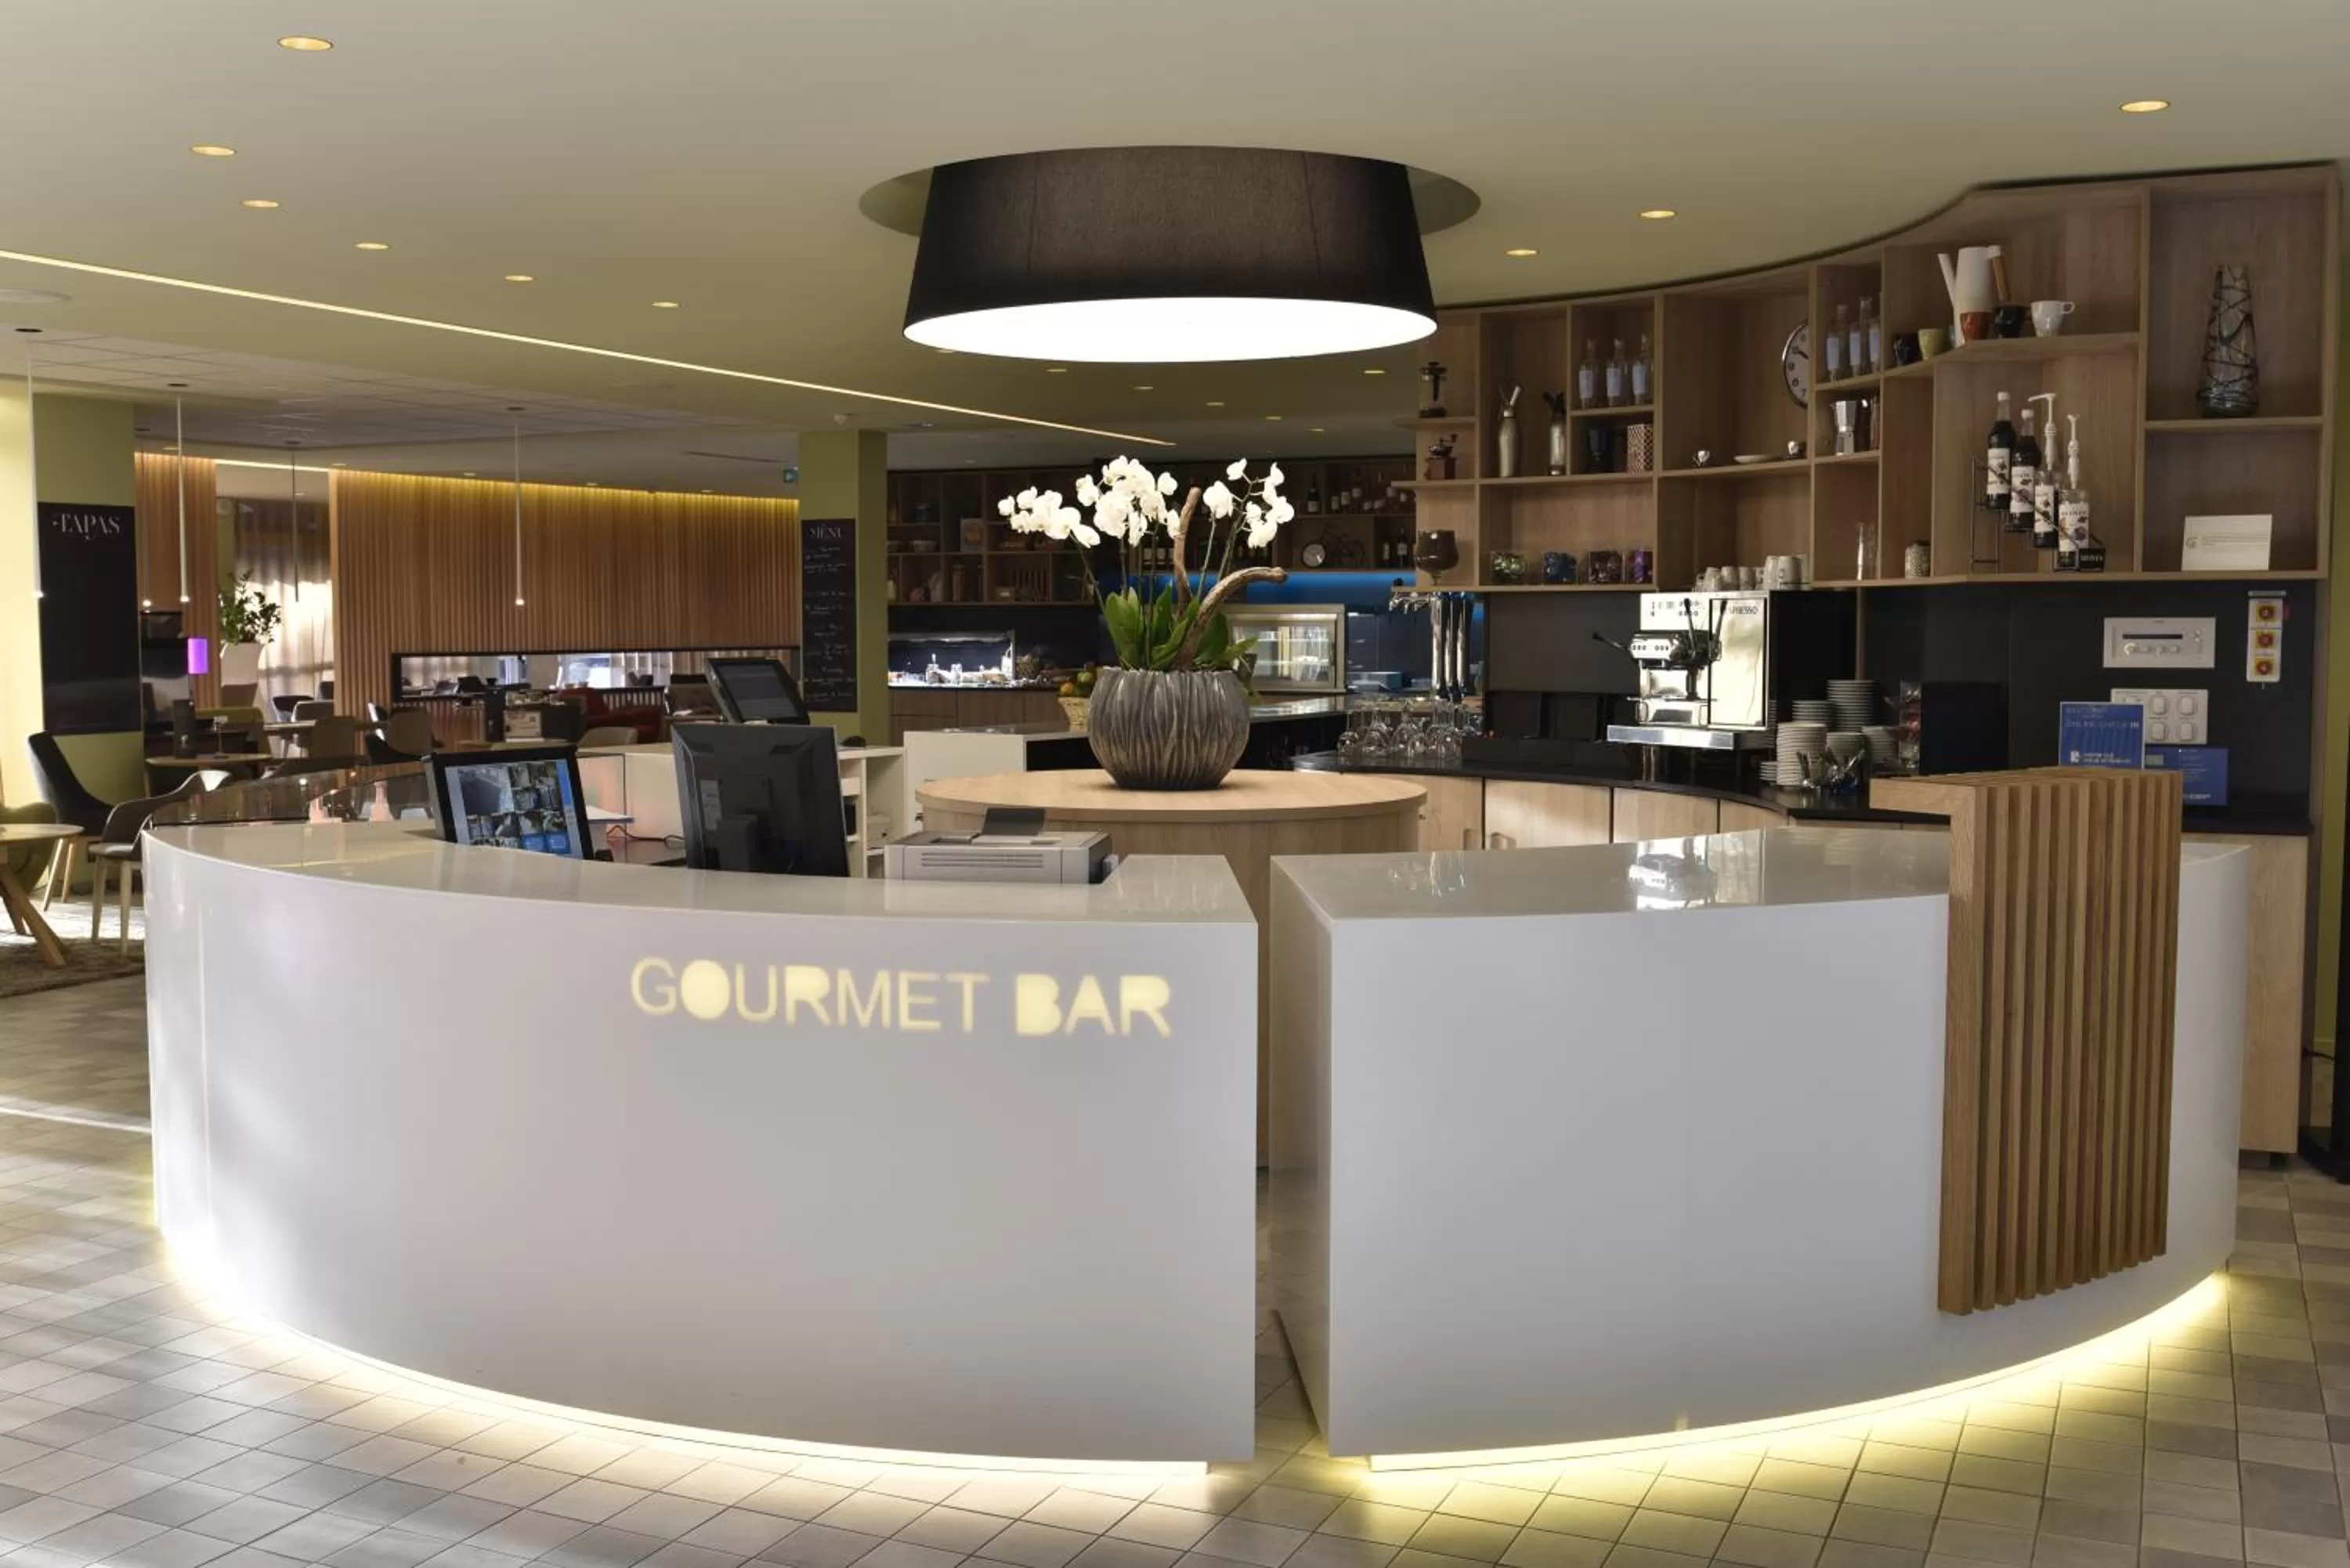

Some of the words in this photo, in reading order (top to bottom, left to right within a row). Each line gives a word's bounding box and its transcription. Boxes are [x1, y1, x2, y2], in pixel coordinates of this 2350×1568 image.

[53, 513, 121, 536] TAPAS
[631, 956, 990, 1032] GOURMET
[1014, 973, 1171, 1038] BAR
